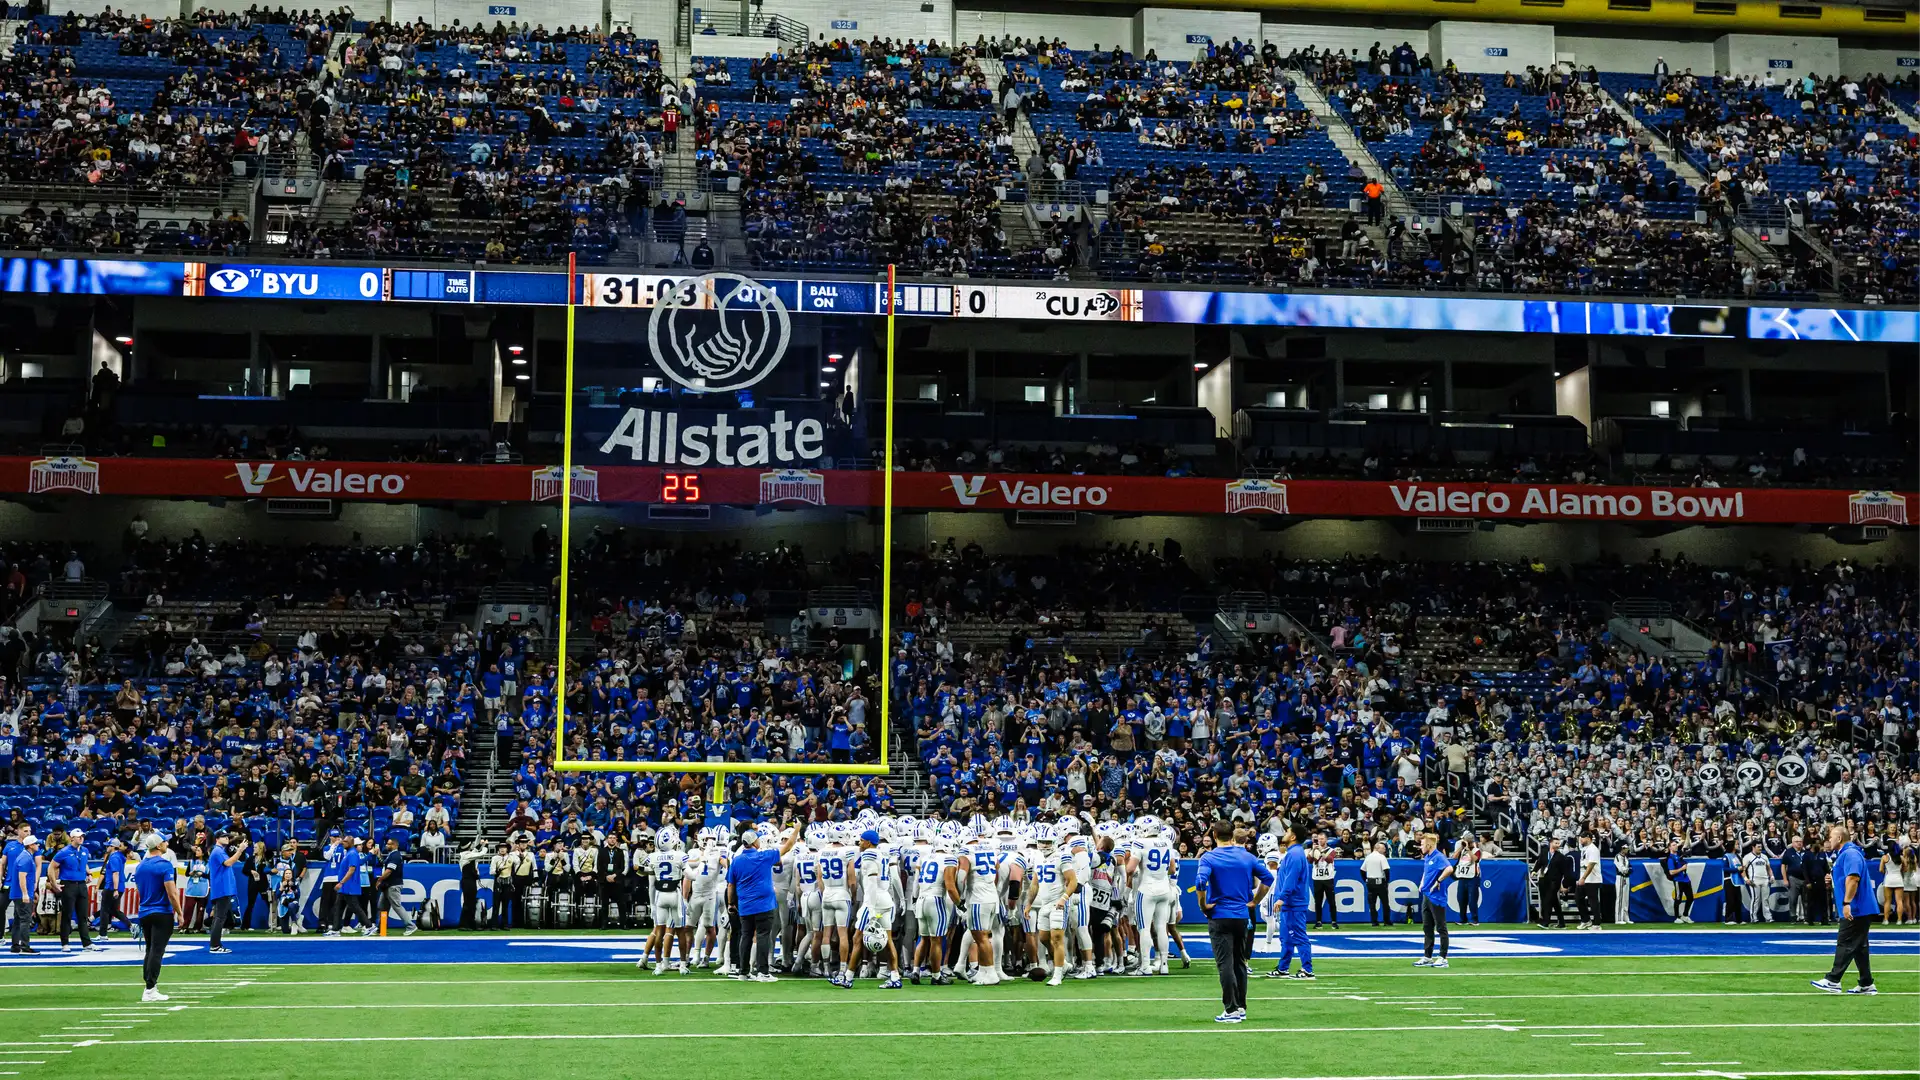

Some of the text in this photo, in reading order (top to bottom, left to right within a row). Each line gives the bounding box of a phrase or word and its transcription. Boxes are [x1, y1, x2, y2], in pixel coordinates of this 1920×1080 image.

[1191, 35, 1206, 43] 326
[1488, 48, 1503, 56] 327
[1901, 58, 1916, 66] 329
[250, 269, 378, 297] 17 BYU 0
[446, 285, 469, 294] OUTS
[447, 278, 467, 287] TIME
[810, 286, 838, 296] BALL
[813, 297, 834, 308] ON
[882, 291, 901, 299] TE
[968, 290, 986, 314] 0
[1035, 292, 1079, 316] 23 CU
[599, 407, 824, 467] Allstate
[288, 467, 405, 493] Valero
[664, 475, 699, 500] 25
[999, 480, 1108, 505] Valero
[1390, 485, 1744, 518] Valero Alamo Bowl
[819, 857, 844, 880] 39
[975, 852, 997, 876] 55
[1147, 848, 1171, 872] 94
[659, 862, 673, 881] 2
[796, 862, 817, 884] 15
[1315, 867, 1330, 877] 194
[1092, 887, 1110, 905] 257
